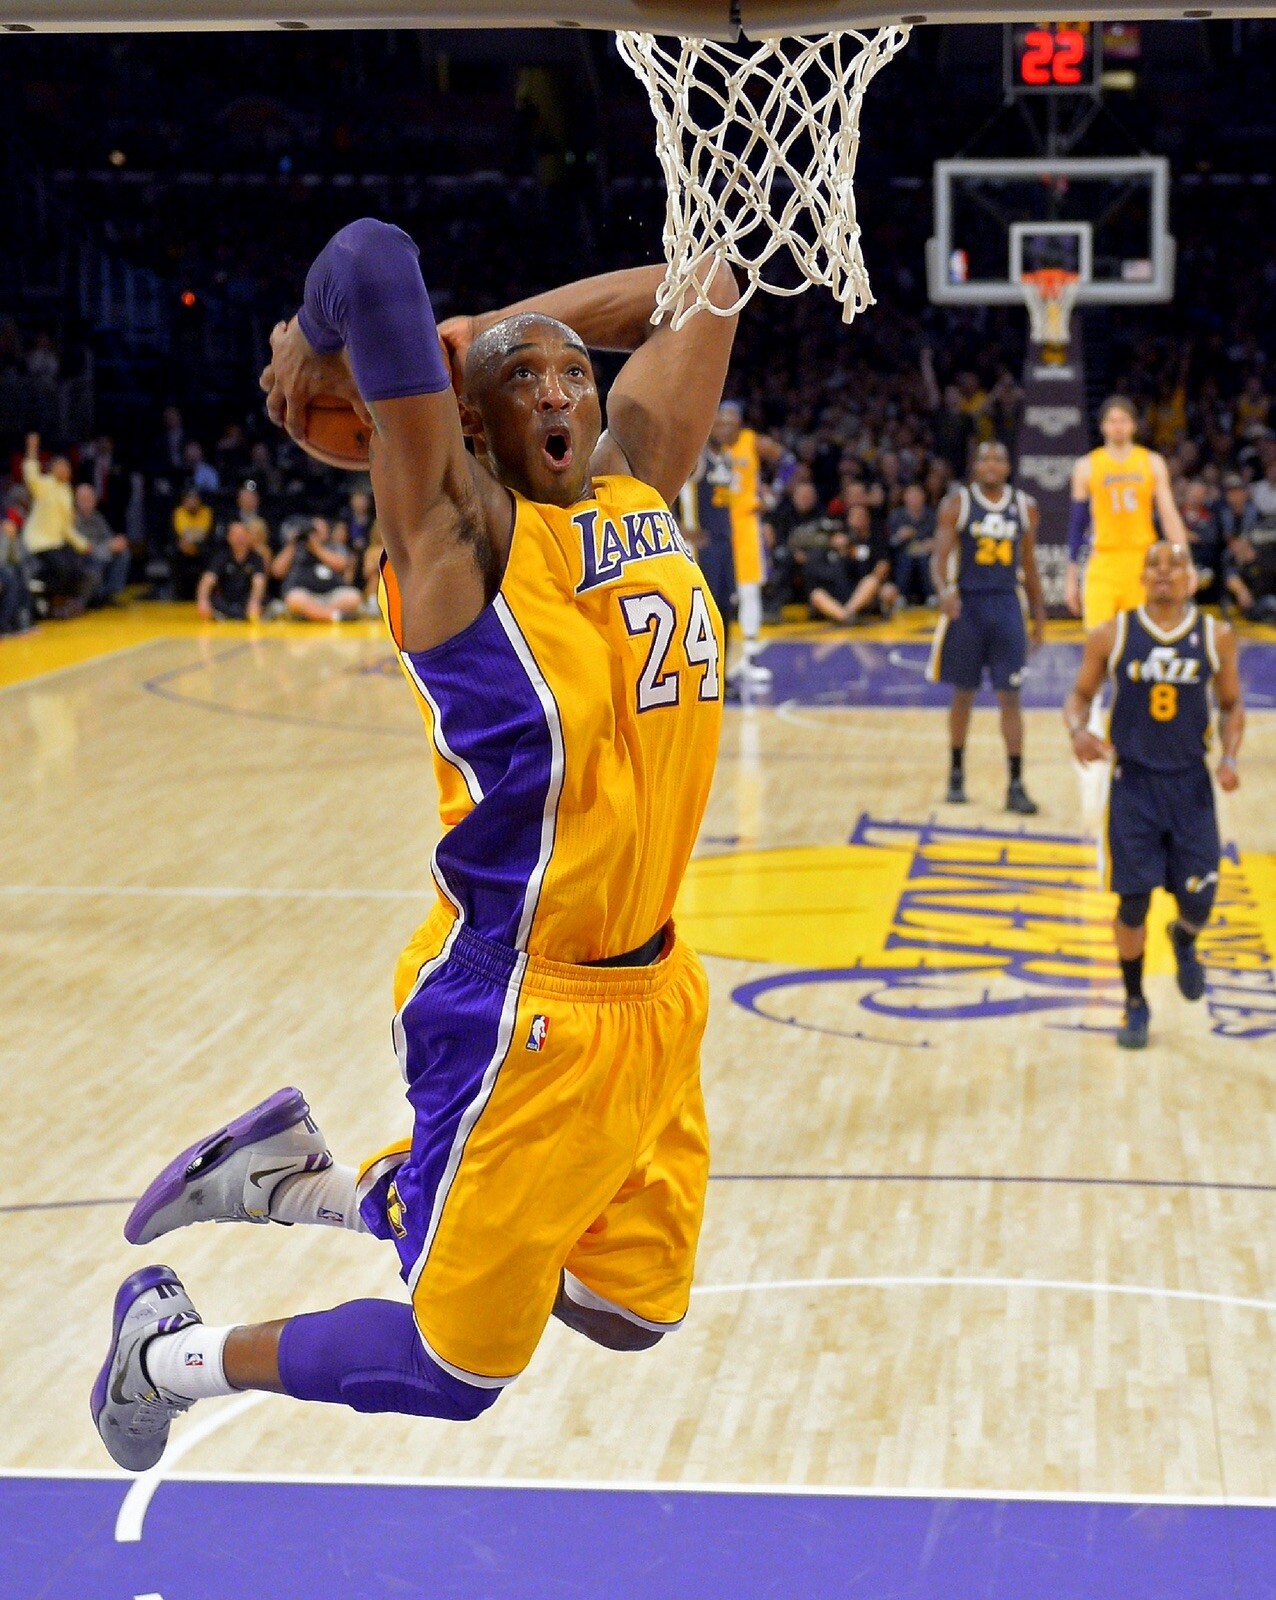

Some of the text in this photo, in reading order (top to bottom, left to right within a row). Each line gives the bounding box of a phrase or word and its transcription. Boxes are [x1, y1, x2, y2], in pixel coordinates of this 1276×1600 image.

[1022, 30, 1085, 85] 22
[1111, 487, 1138, 514] 16
[974, 535, 1013, 566] 24
[618, 587, 719, 714] 24
[1149, 682, 1178, 722] 8
